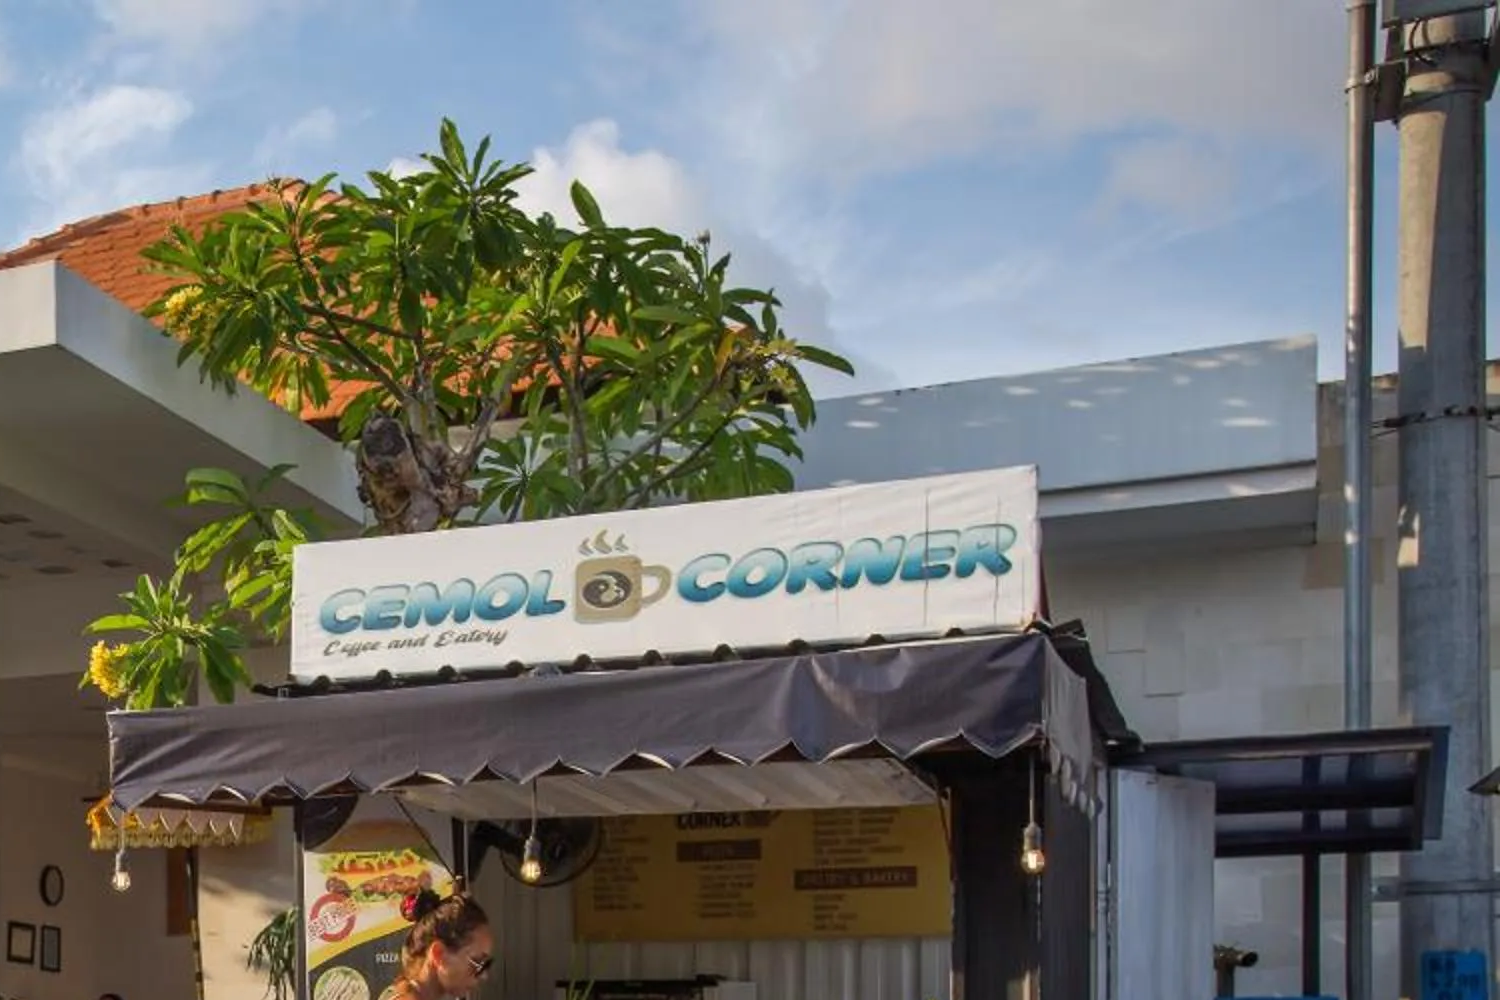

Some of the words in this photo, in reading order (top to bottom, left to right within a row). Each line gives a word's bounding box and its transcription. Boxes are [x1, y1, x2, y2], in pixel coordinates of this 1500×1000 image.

[318, 569, 565, 635] CEMOL
[677, 522, 1018, 603] CORNER
[323, 640, 381, 658] Coffee
[388, 634, 431, 649] and
[434, 628, 508, 649] Eatery
